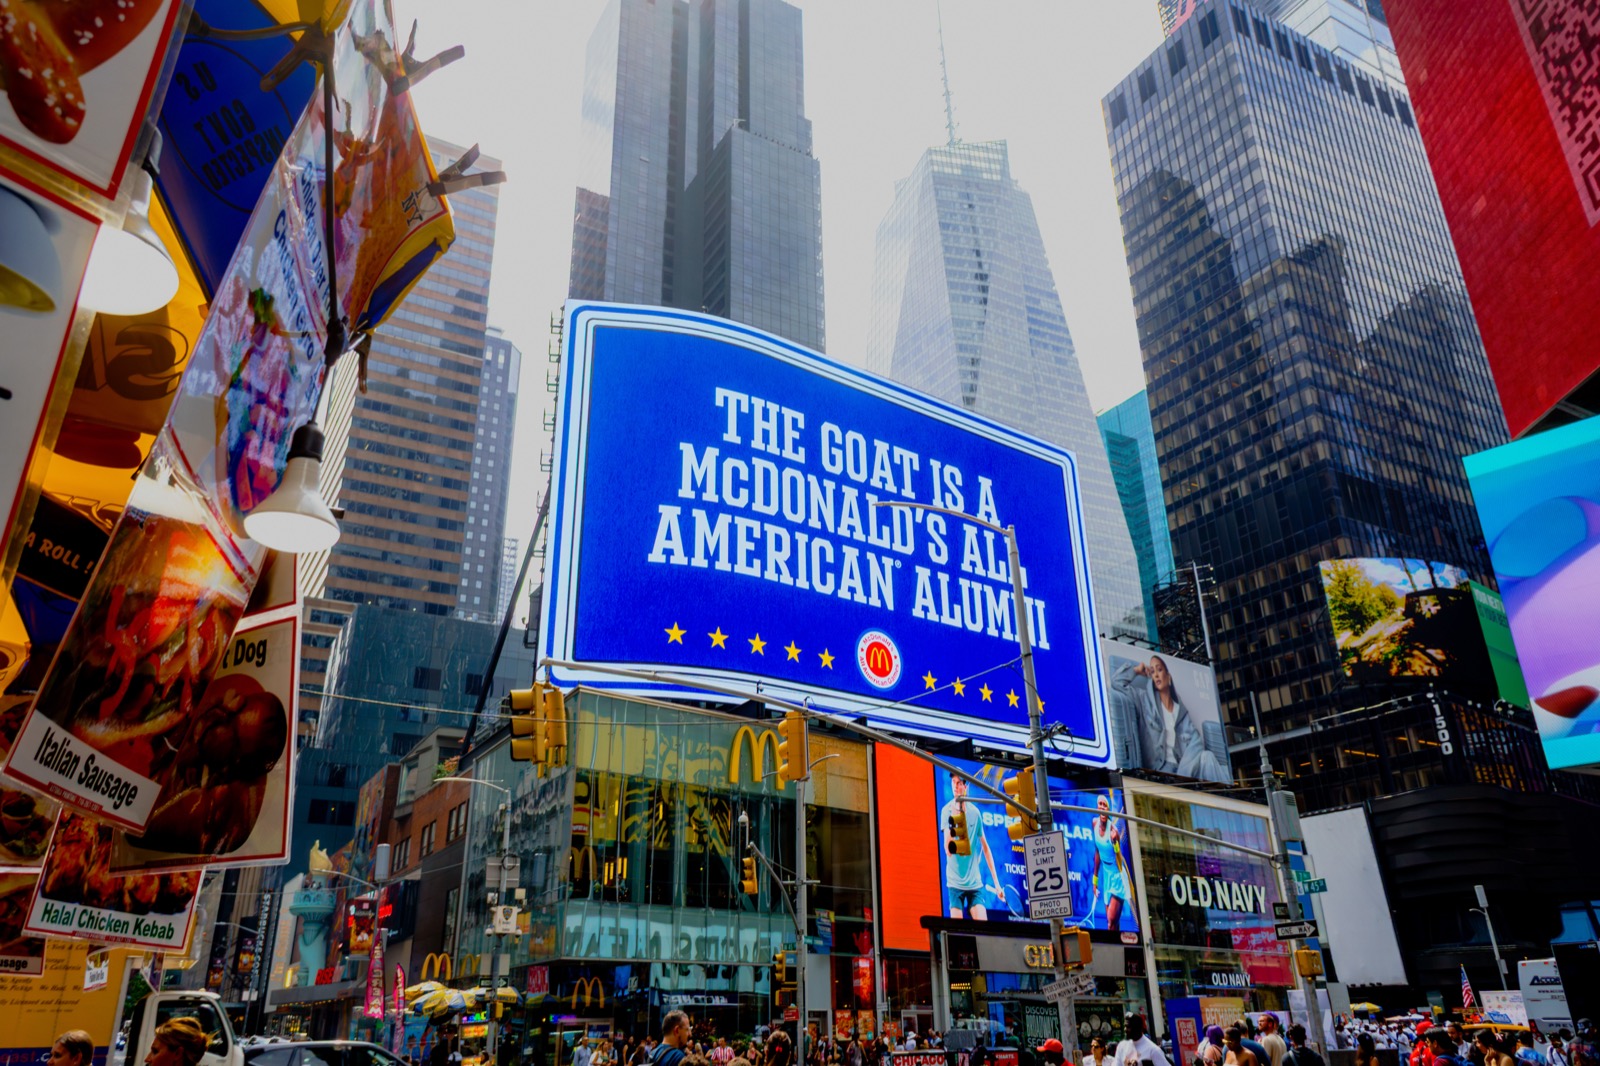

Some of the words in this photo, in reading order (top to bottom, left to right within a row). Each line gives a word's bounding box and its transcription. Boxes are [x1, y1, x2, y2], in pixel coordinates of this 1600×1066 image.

[274, 209, 299, 310] Chicken
[715, 386, 806, 464] THE
[821, 421, 919, 500] GOAT
[930, 458, 965, 514] IS
[976, 475, 1001, 526] A
[39, 538, 79, 570] ROLL
[912, 565, 1051, 651] ALUMNI
[233, 638, 268, 668] Dog
[1432, 703, 1454, 756] 1500
[33, 727, 81, 780] Italian
[78, 752, 139, 810] Sausage
[1032, 846, 1056, 855] SPEED
[1035, 837, 1051, 846] CITY
[1036, 856, 1055, 866] LIMIT
[1032, 867, 1064, 892] 25
[1040, 900, 1061, 908] PHOTO
[1170, 874, 1212, 907] OLD
[1214, 880, 1266, 914] NAVY
[41, 902, 74, 928] Halal
[77, 907, 130, 937] Chicken
[132, 918, 175, 941] Kebab
[1034, 907, 1068, 917] ENFORCED
[1280, 927, 1292, 936] ONE
[1298, 926, 1312, 934] WAY
[1211, 972, 1228, 986] OLD
[1228, 973, 1251, 987] NAVY
[1025, 1005, 1058, 1016] DISCOVER
[893, 1054, 945, 1066] CHICAGO
